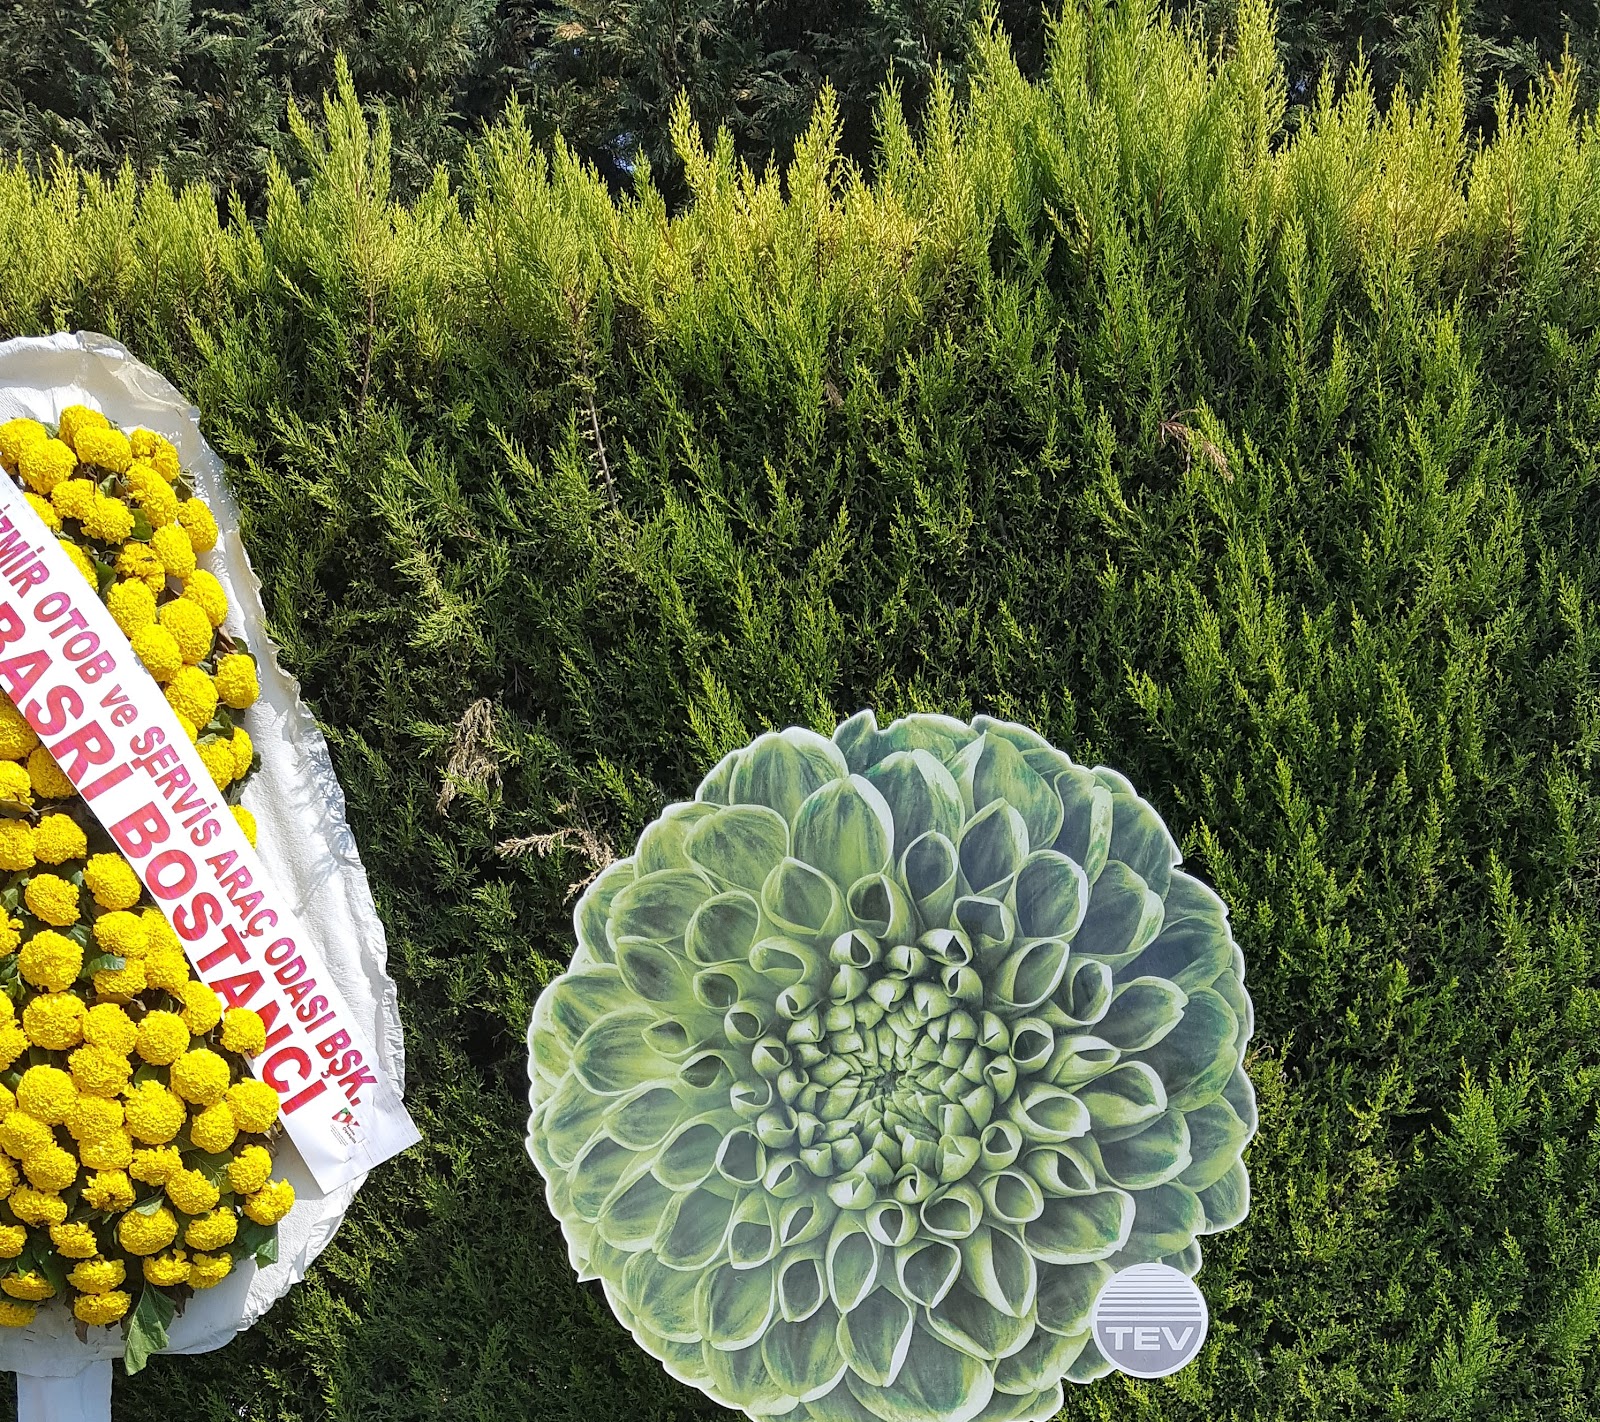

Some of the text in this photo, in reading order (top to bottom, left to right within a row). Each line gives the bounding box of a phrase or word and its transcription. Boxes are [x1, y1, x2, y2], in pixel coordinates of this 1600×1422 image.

[33, 591, 117, 685] OTOB
[99, 683, 139, 728] ve
[130, 726, 222, 847] SERVİS
[204, 849, 279, 940] ARAÇ
[264, 937, 337, 1034] ODASI
[315, 1028, 378, 1107] BŞK.
[1105, 1326, 1195, 1351] TEV
